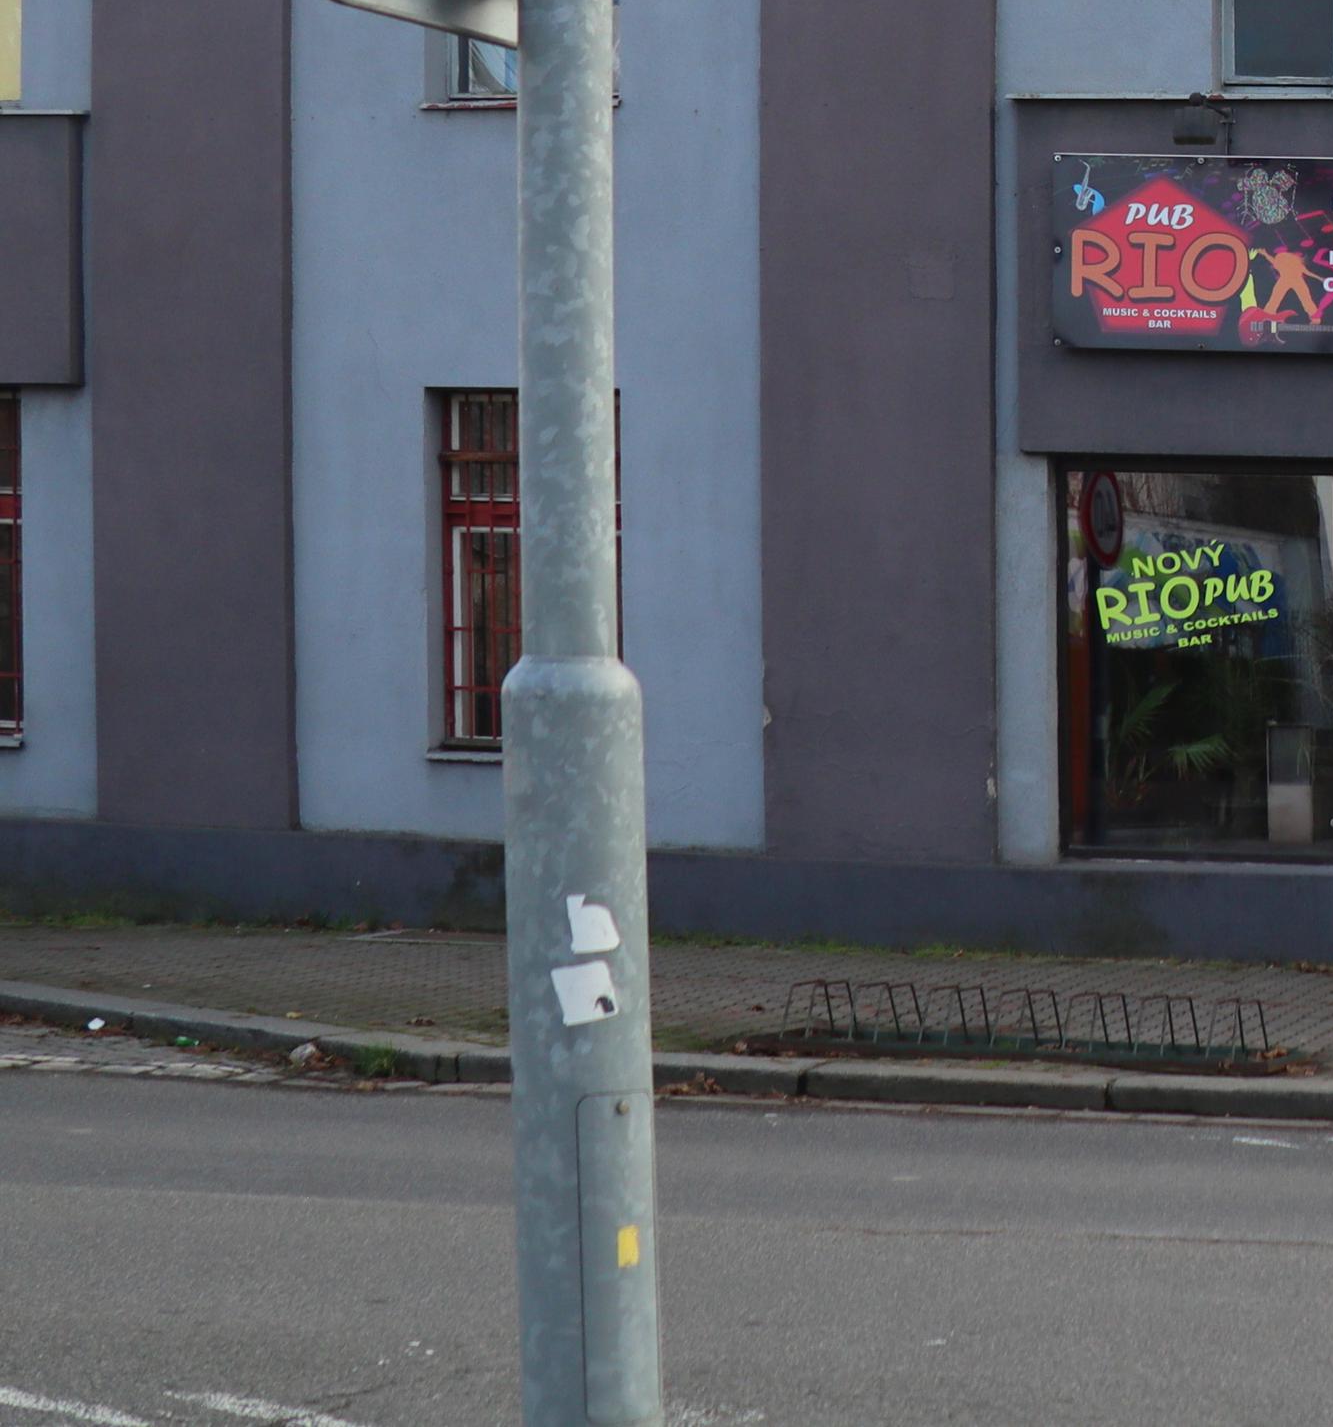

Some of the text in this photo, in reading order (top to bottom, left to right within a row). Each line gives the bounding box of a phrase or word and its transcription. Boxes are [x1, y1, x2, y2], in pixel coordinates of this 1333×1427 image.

[1124, 202, 1194, 229] PUB
[1070, 228, 1250, 303] RIO
[1103, 307, 1217, 319] MUSIC & COCKTAILS
[1147, 319, 1172, 329] BAR
[1131, 539, 1226, 577] NOVÝ
[1095, 569, 1275, 630] RIO PUB
[1106, 608, 1279, 644] MUSIC & COCKTAILS
[1177, 633, 1213, 649] BAR
